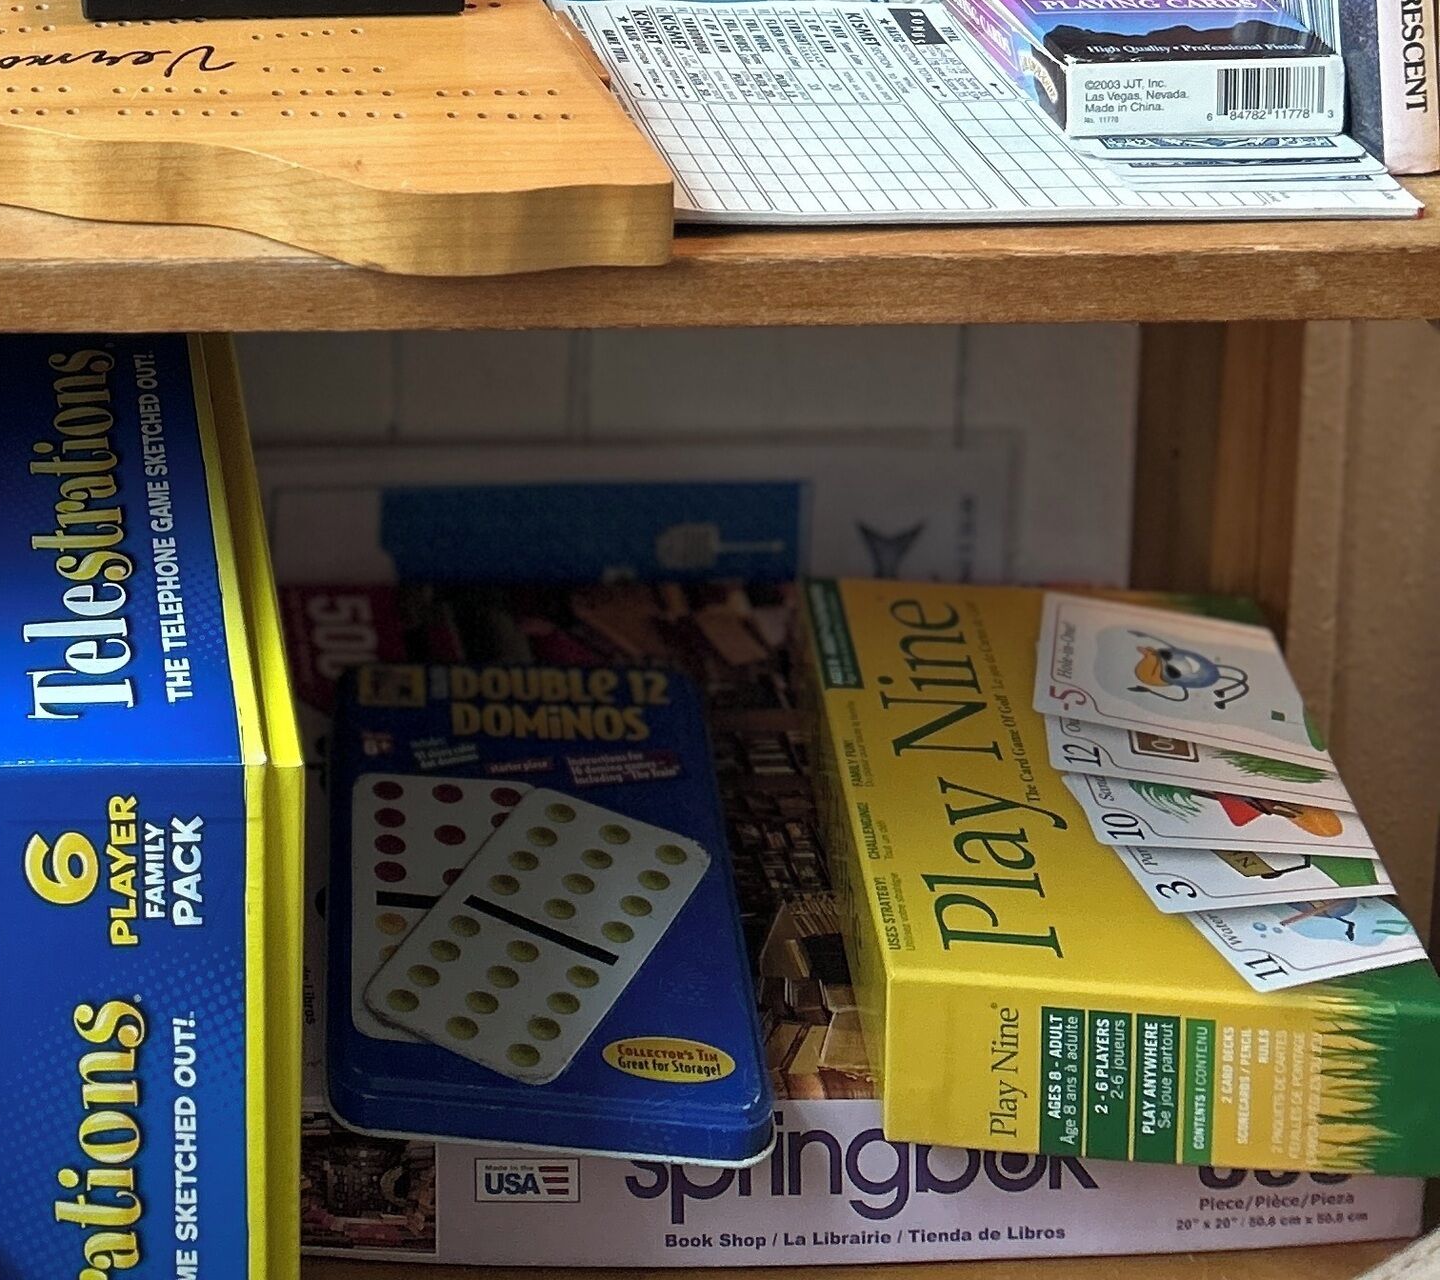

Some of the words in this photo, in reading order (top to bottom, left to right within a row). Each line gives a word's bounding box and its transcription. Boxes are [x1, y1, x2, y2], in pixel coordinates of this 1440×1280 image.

[1040, 0, 1160, 11] PLAYING
[24, 349, 136, 719] Telestrations
[881, 598, 1002, 761] Nine
[24, 831, 100, 905] 6
[108, 794, 140, 945] PLAYER
[144, 823, 166, 920] FAMILY
[171, 815, 205, 927] PACK
[920, 777, 1069, 959] Play
[1143, 1022, 1159, 1098] ANYWHERE
[1142, 1101, 1157, 1134] PLAY
[484, 1173, 540, 1195] USA
[664, 1234, 713, 1249] Book
[719, 1233, 767, 1250] Shop
[908, 1228, 973, 1243] Tienda
[978, 1227, 1000, 1241] de
[1007, 1224, 1066, 1241] Libros
